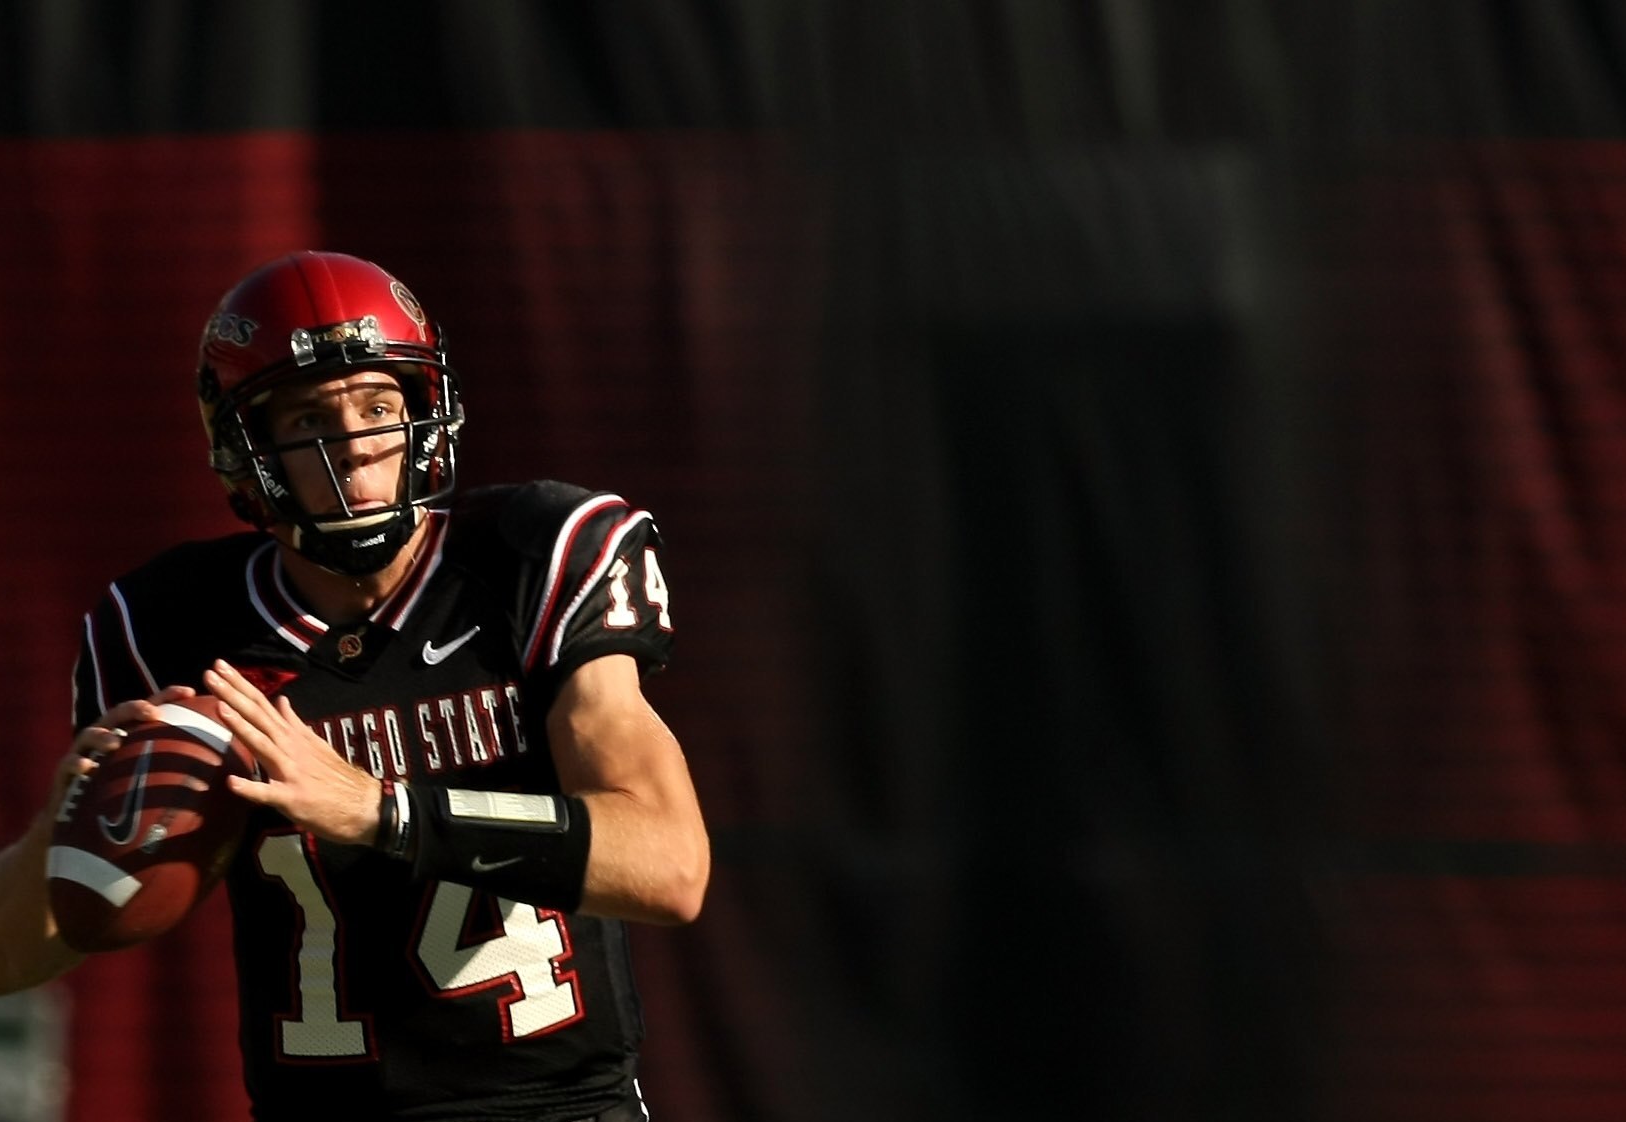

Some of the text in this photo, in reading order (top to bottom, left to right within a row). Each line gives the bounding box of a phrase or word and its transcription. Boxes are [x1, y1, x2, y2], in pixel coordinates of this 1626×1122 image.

[603, 546, 673, 630] 14
[417, 681, 529, 772] STATE
[254, 831, 586, 1063] 14
